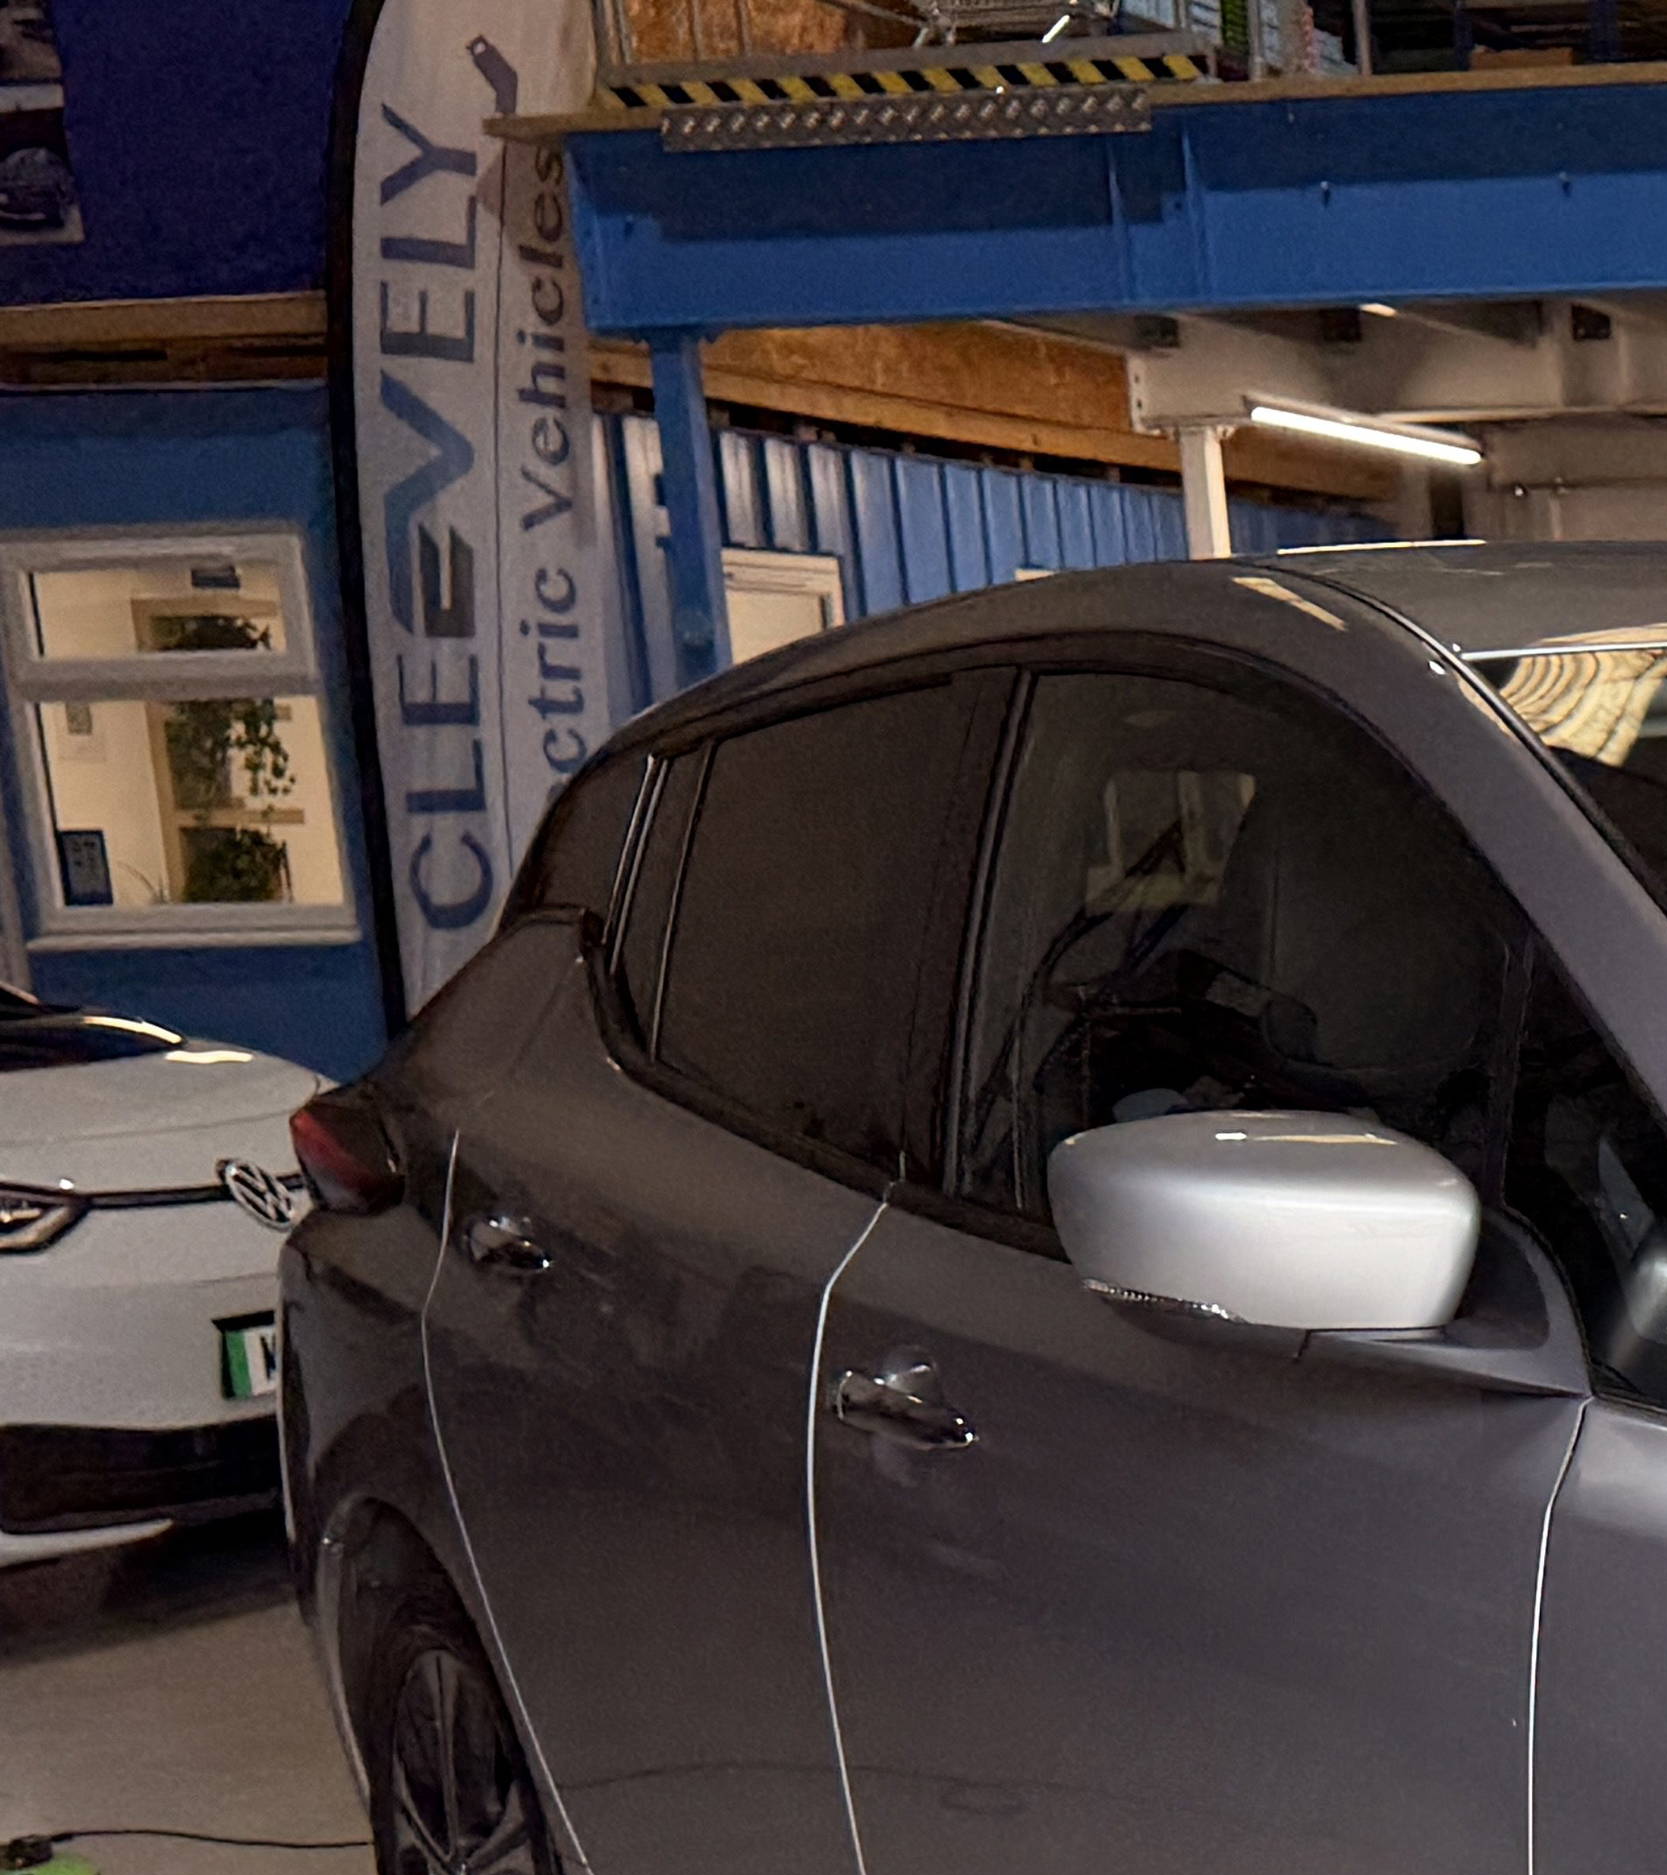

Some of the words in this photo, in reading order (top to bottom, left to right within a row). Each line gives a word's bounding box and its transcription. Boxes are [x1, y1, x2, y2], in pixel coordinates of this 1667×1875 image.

[379, 102, 494, 931] CLEEVELY
[515, 144, 574, 532] Vehicles
[517, 566, 588, 800] ctric
